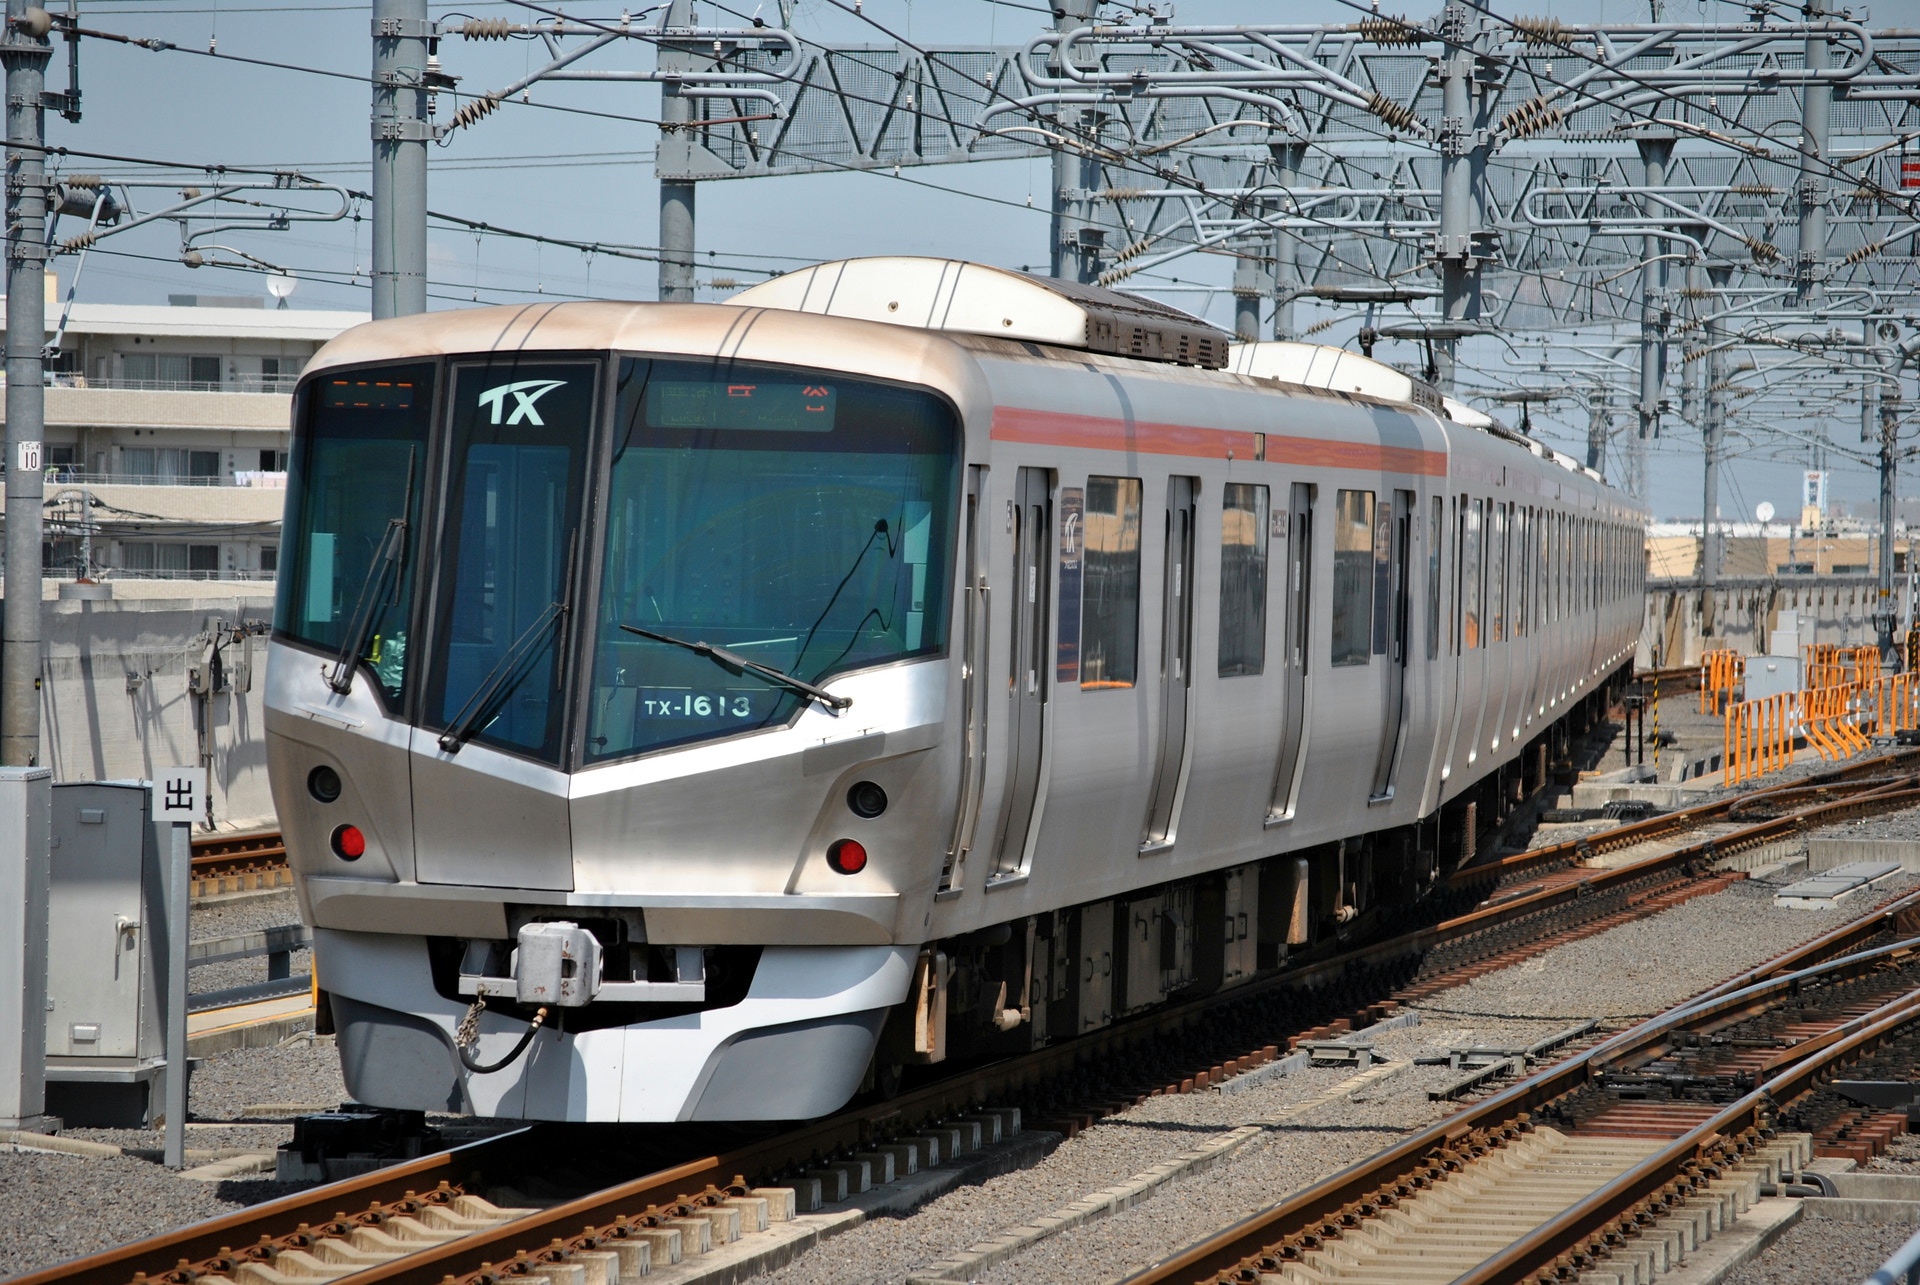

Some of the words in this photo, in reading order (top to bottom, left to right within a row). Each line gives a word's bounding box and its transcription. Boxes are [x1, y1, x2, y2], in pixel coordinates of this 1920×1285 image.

[479, 380, 568, 425] TX
[25, 452, 37, 469] 10
[644, 695, 750, 718] TX-1613
[165, 778, 193, 811] 出
